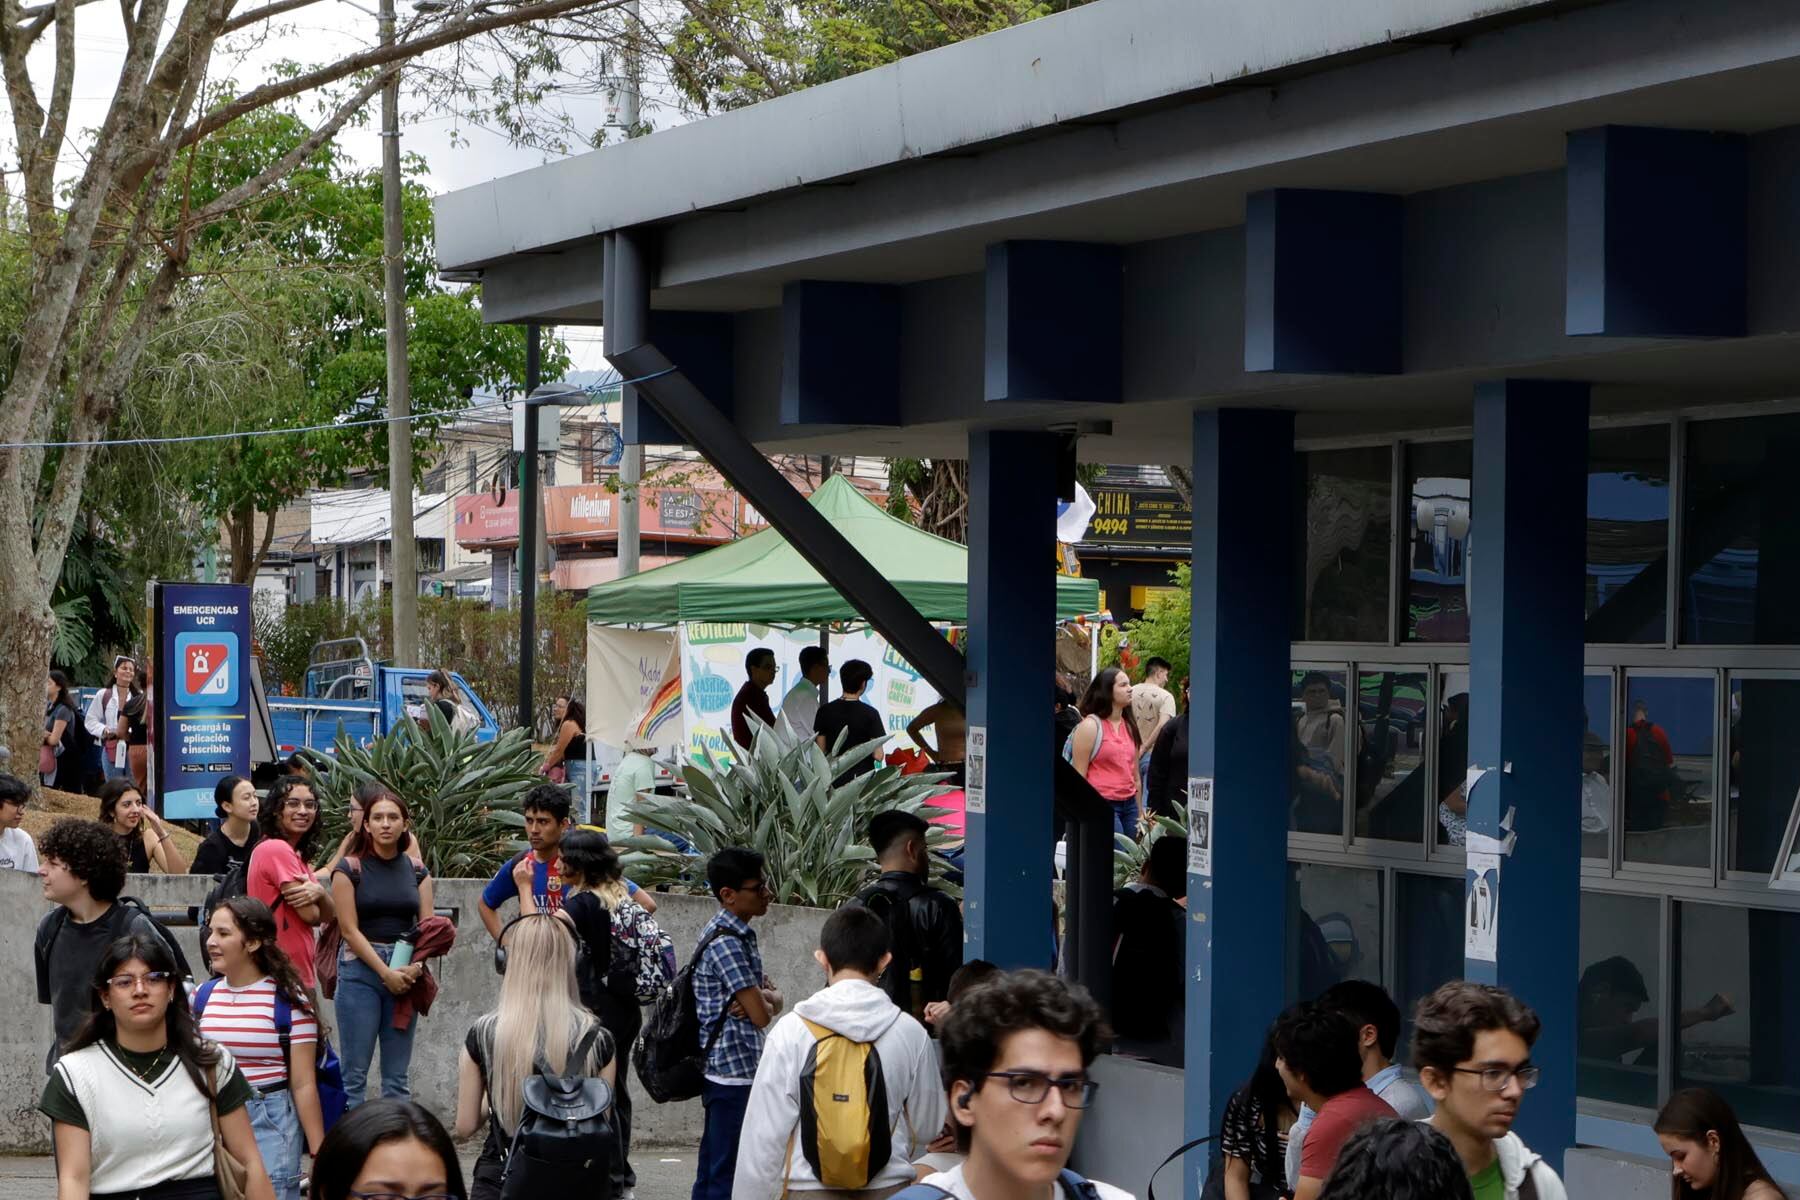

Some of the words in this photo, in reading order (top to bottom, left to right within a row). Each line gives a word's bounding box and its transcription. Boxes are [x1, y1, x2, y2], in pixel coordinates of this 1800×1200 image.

[570, 492, 611, 519] Millenium
[1097, 492, 1130, 515] CHINA
[664, 508, 673, 517] SE
[173, 606, 239, 615] EMERGENCIAS
[196, 616, 215, 625] UCR
[180, 723, 221, 733] Descargá
[222, 723, 231, 731] la
[183, 733, 230, 744] aplicación
[188, 744, 232, 754] inscribite
[532, 895, 564, 907] ATAR
